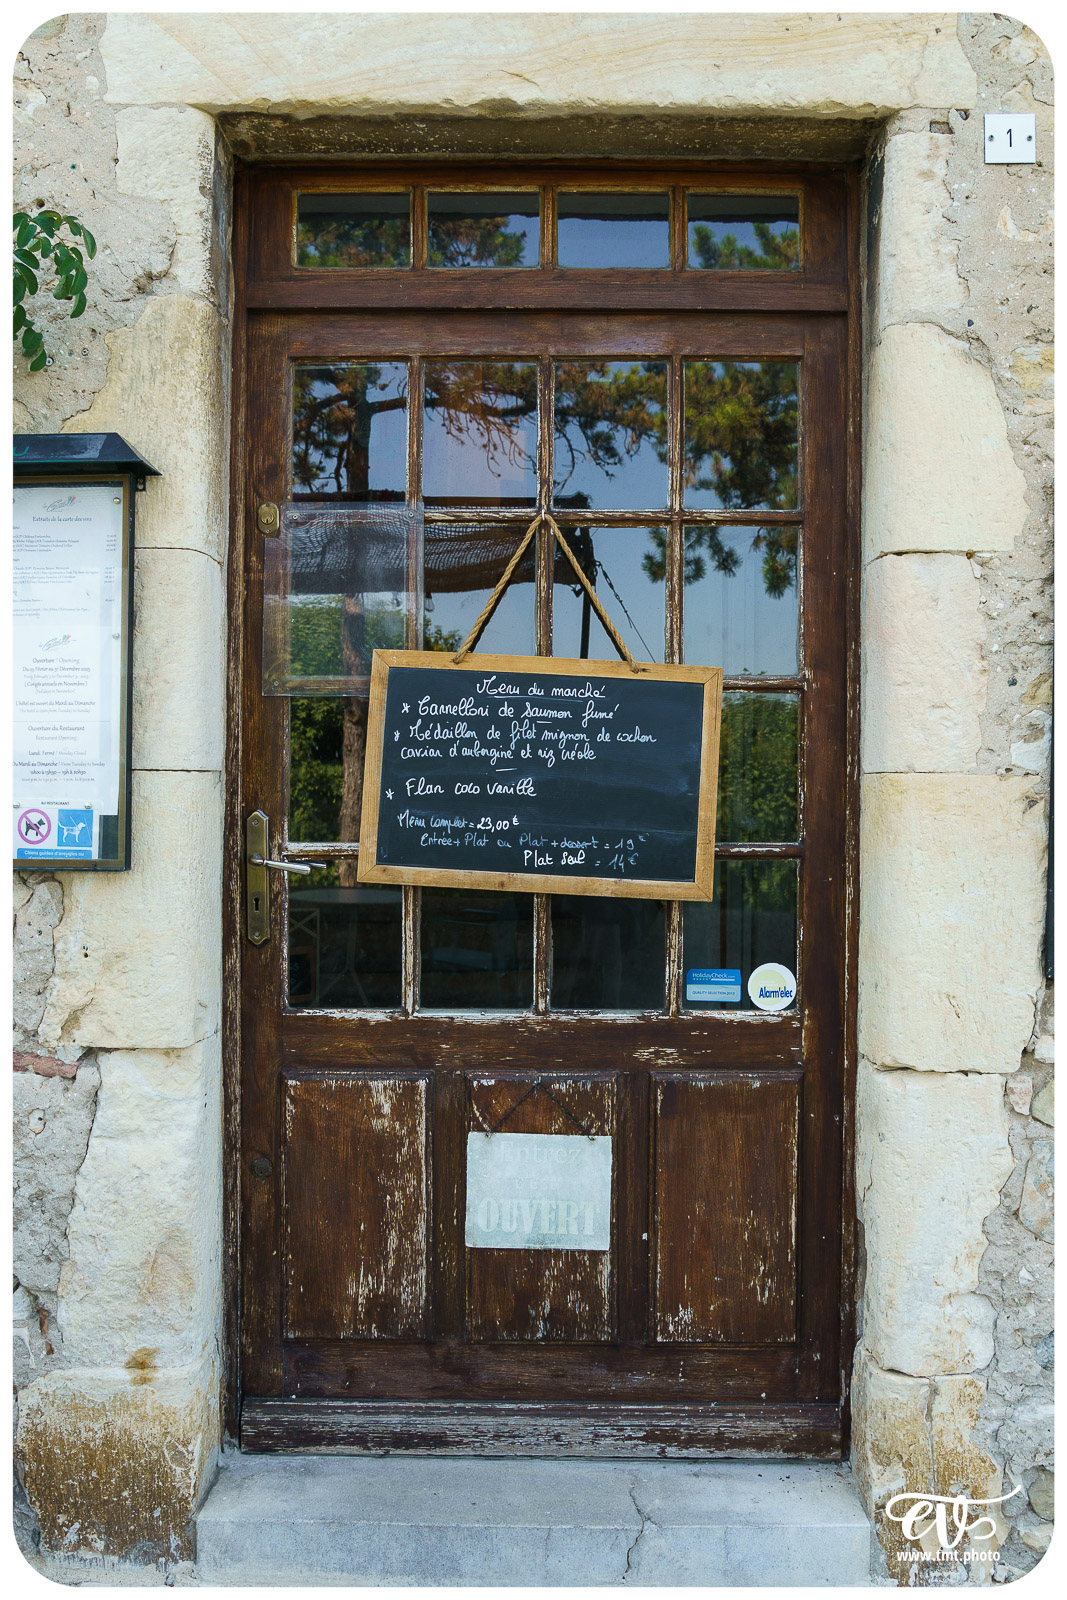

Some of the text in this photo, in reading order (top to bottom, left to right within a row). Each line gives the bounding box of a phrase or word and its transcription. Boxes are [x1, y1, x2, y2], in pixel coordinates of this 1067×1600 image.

[1006, 128, 1013, 148] 1
[528, 682, 544, 696] du
[551, 681, 606, 698] marché
[498, 701, 514, 718] de
[582, 700, 620, 728] fumé
[486, 724, 501, 740] de
[509, 718, 537, 750] filet
[541, 728, 590, 749] mignon
[596, 726, 611, 742] de
[520, 743, 533, 759] et
[405, 776, 445, 797] Flan
[454, 782, 481, 796] coco
[464, 832, 489, 848] Plat
[519, 832, 549, 848] Plat
[523, 849, 554, 868] Plat
[499, 1140, 582, 1165] Entrez
[477, 1198, 597, 1236] OUVERT
